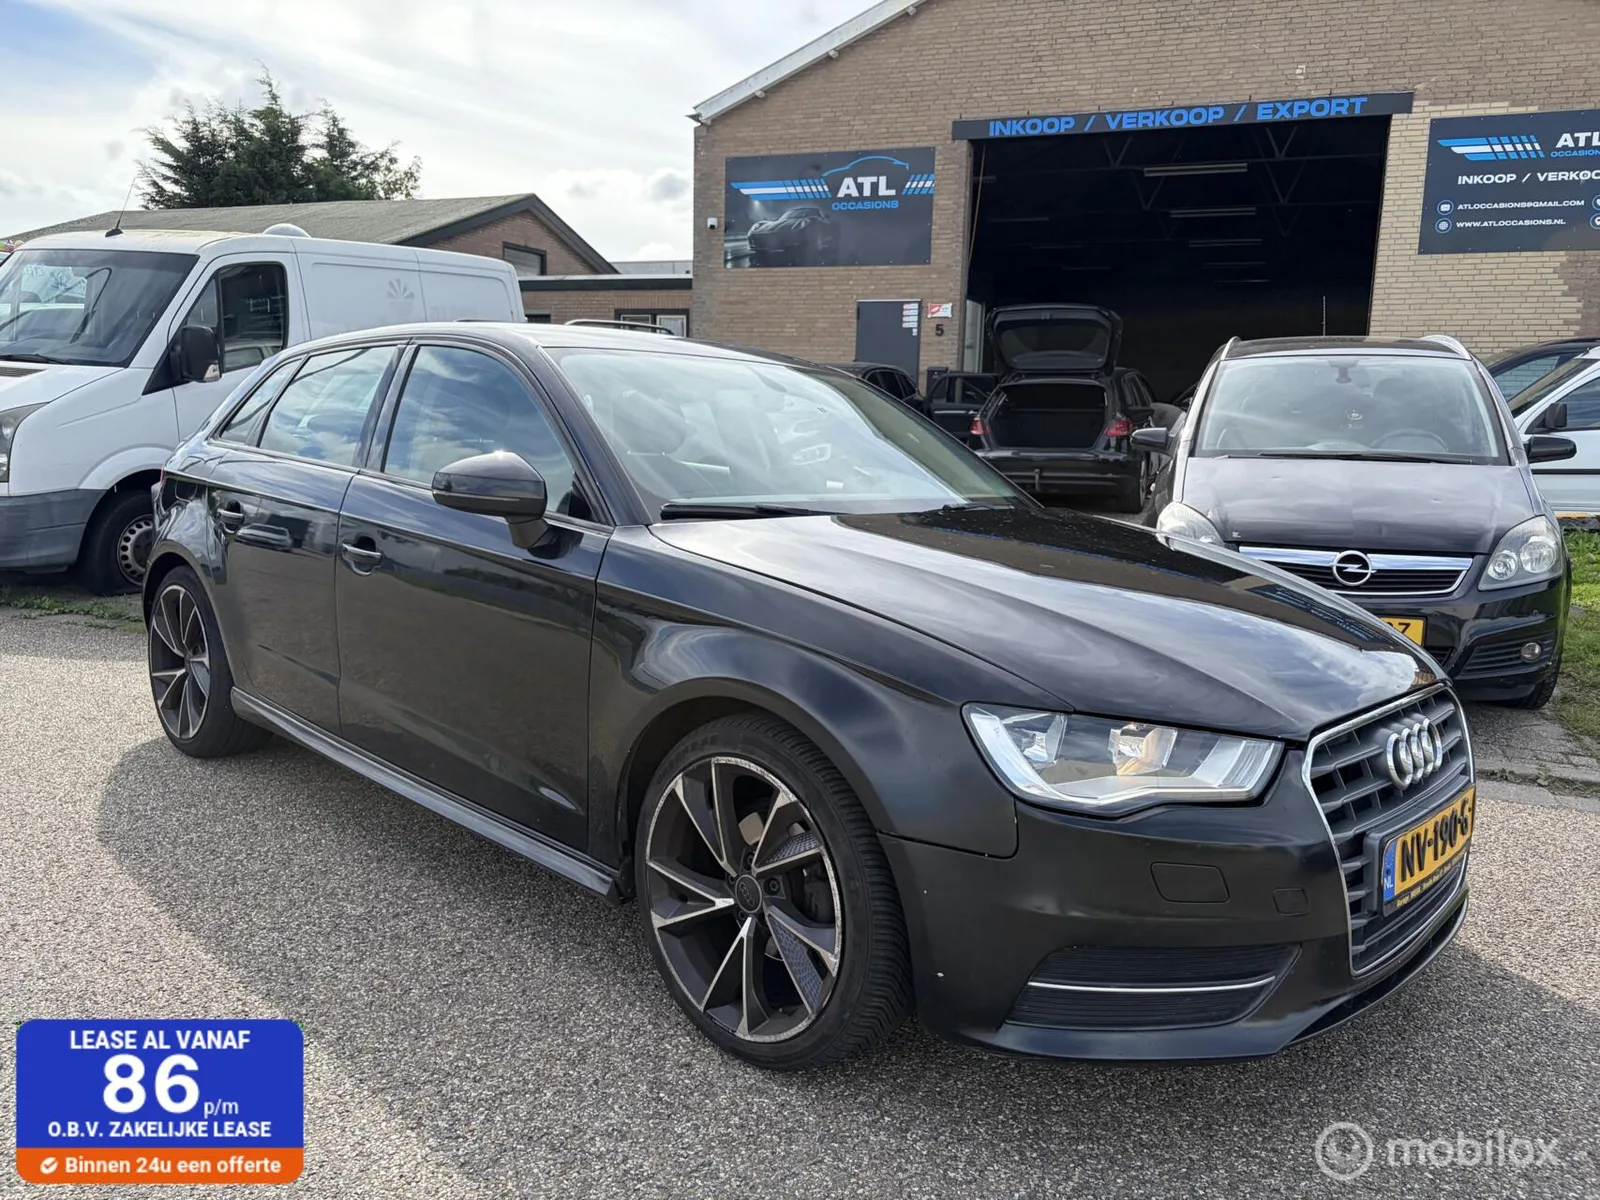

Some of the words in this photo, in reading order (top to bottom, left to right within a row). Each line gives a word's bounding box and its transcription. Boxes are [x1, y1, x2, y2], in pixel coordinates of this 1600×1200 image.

[988, 116, 1076, 137] INKOOP
[1083, 114, 1097, 132] /
[1105, 106, 1225, 130] VERKOOP
[1233, 104, 1247, 122] /
[1256, 96, 1368, 121] EXPORT
[1457, 173, 1517, 185] INKOOP
[836, 175, 897, 199] ATL
[831, 200, 900, 212] OCCASIONS
[1455, 218, 1566, 229] WWW.ATLOCCASIONS.NL
[935, 323, 944, 337] 5
[1383, 875, 1395, 891] NL
